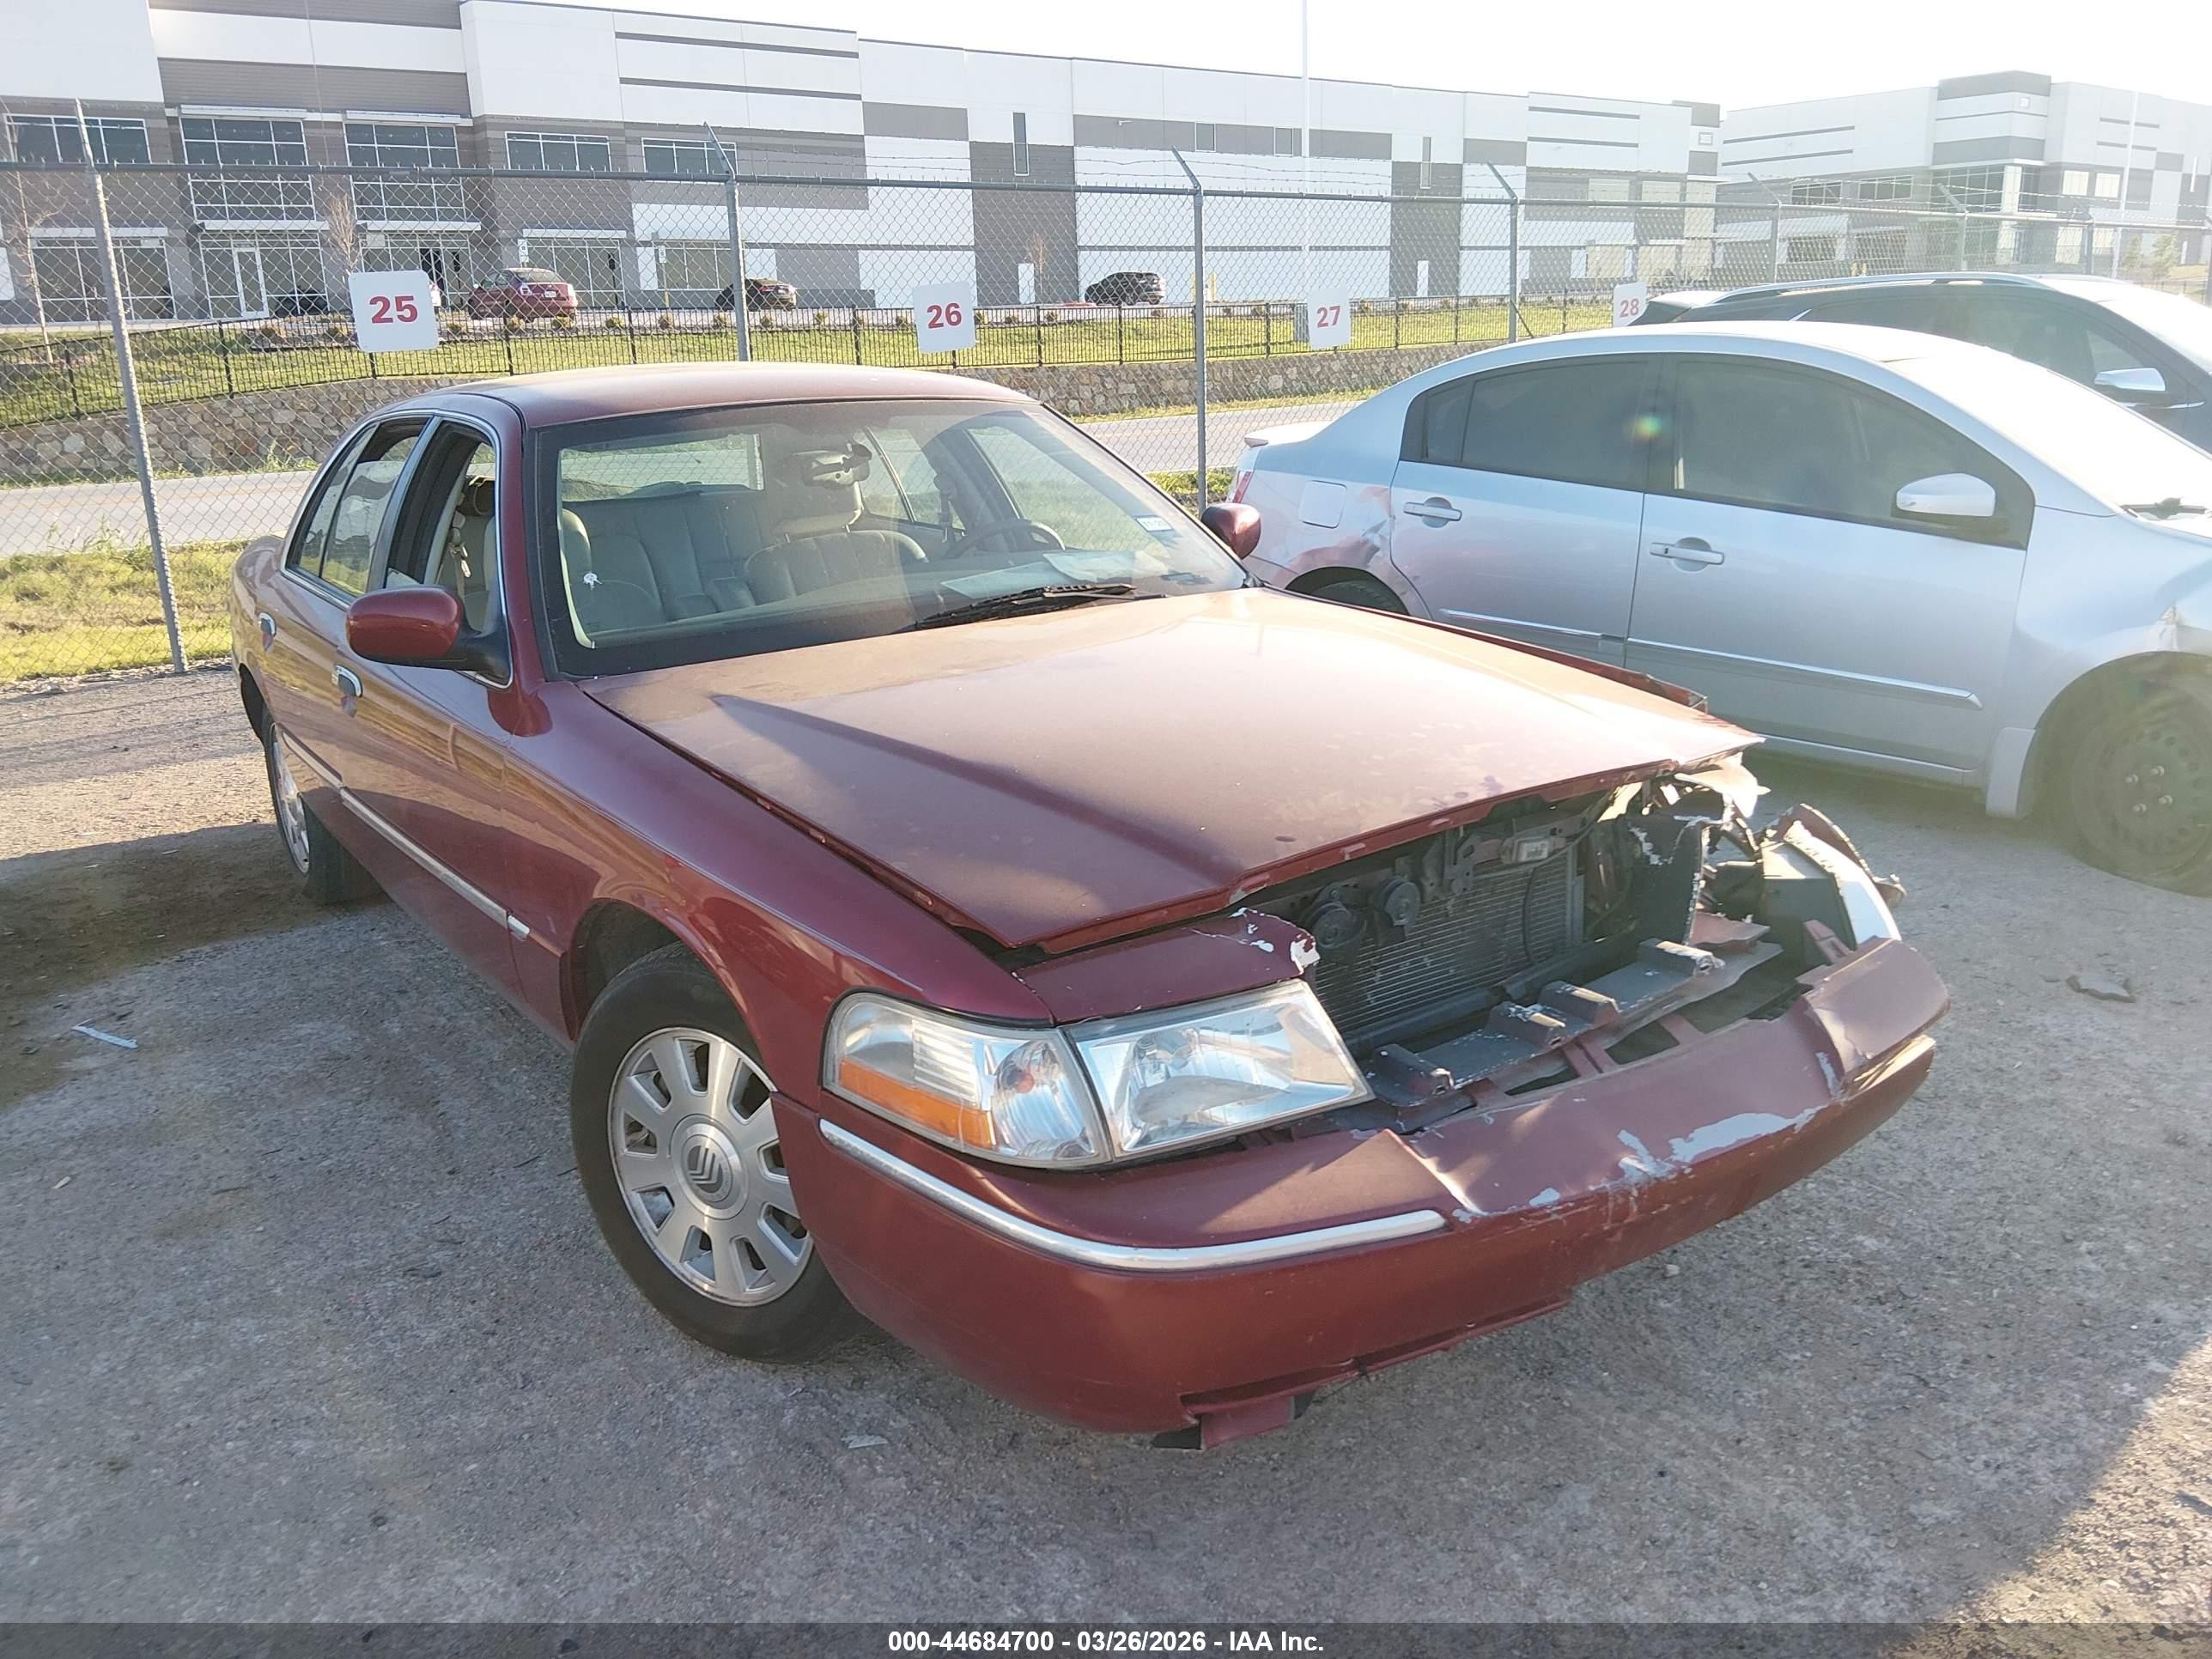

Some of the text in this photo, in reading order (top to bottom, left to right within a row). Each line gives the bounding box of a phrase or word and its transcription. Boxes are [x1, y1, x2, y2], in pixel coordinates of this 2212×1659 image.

[369, 295, 418, 324] 25
[927, 302, 962, 329] 26
[1316, 305, 1340, 328] 27
[1620, 298, 1639, 318] 28
